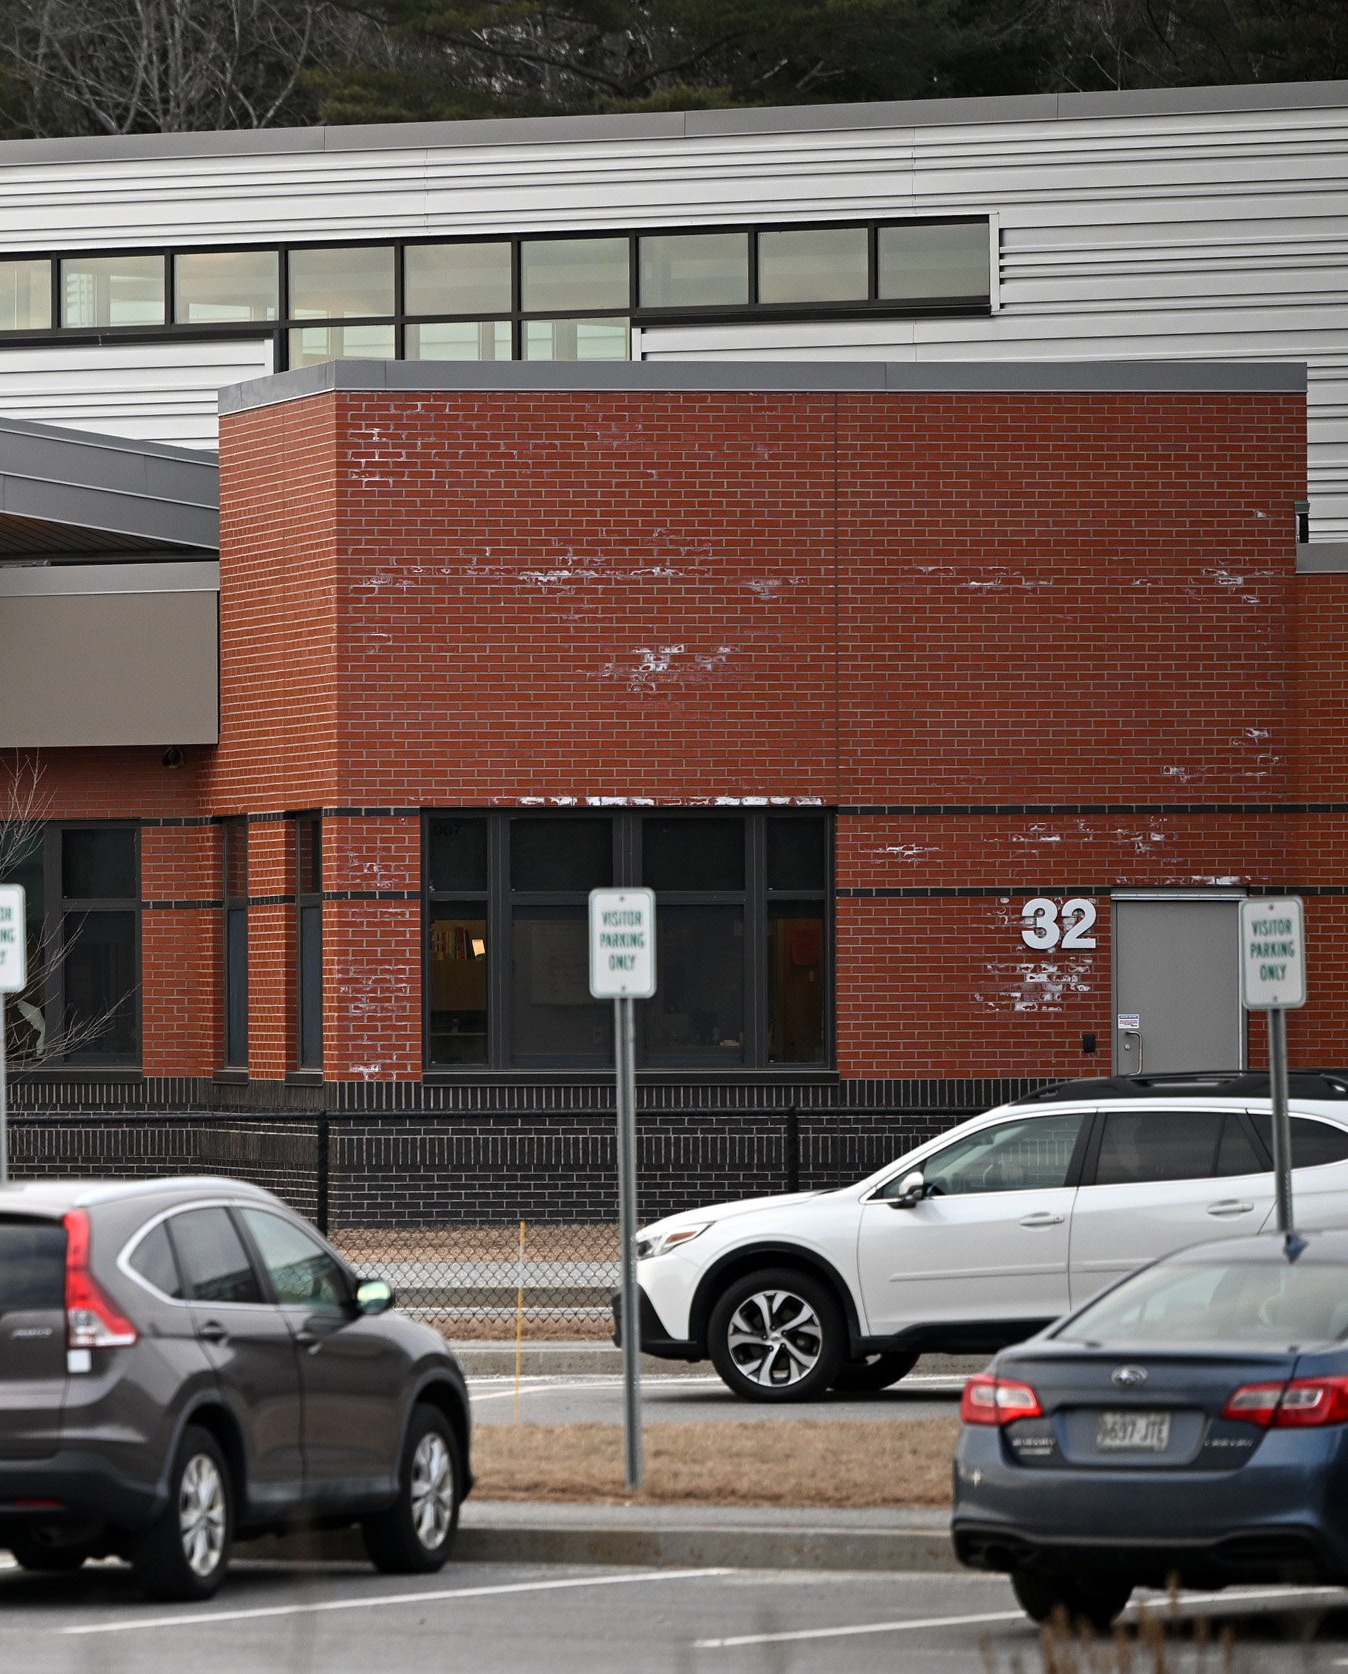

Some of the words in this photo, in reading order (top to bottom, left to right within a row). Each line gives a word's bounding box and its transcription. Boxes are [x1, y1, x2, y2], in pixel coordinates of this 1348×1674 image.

[602, 910, 642, 926] VISITOR
[1022, 898, 1097, 950] 32
[1252, 919, 1292, 936] VISITOR
[599, 932, 645, 948] PARKING
[1250, 942, 1295, 958] PARKING
[609, 954, 635, 971] ONLY
[1260, 964, 1286, 981] ONLY
